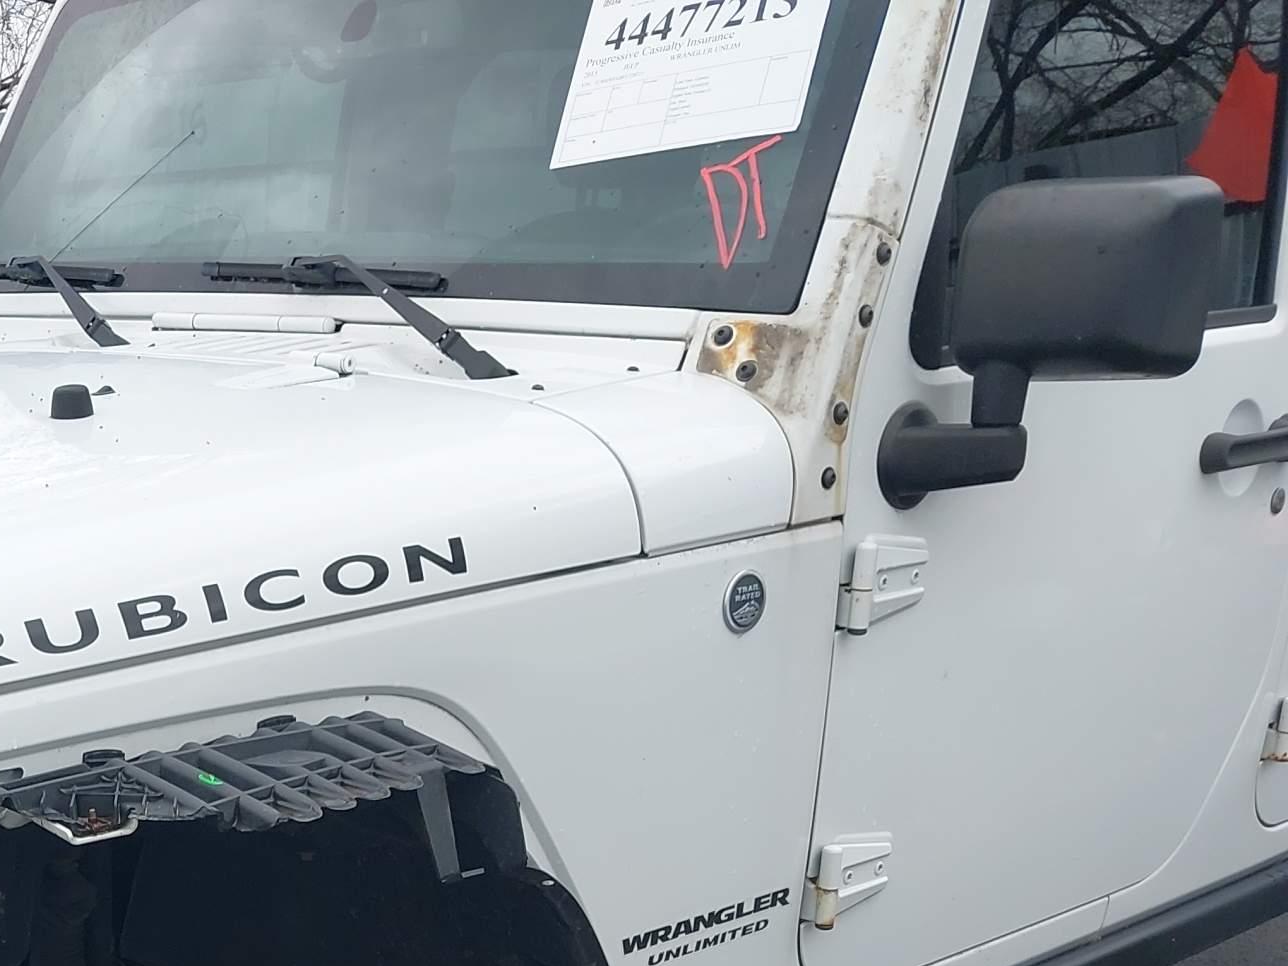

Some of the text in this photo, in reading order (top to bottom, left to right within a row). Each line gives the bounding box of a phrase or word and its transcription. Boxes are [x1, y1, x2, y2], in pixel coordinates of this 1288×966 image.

[585, 31, 736, 68] Progressive Casualty Insurance
[734, 591, 762, 602] RATED
[736, 583, 760, 595] TRAIL
[621, 887, 790, 956] WRANGLER
[647, 918, 770, 966] UNLIMITED
